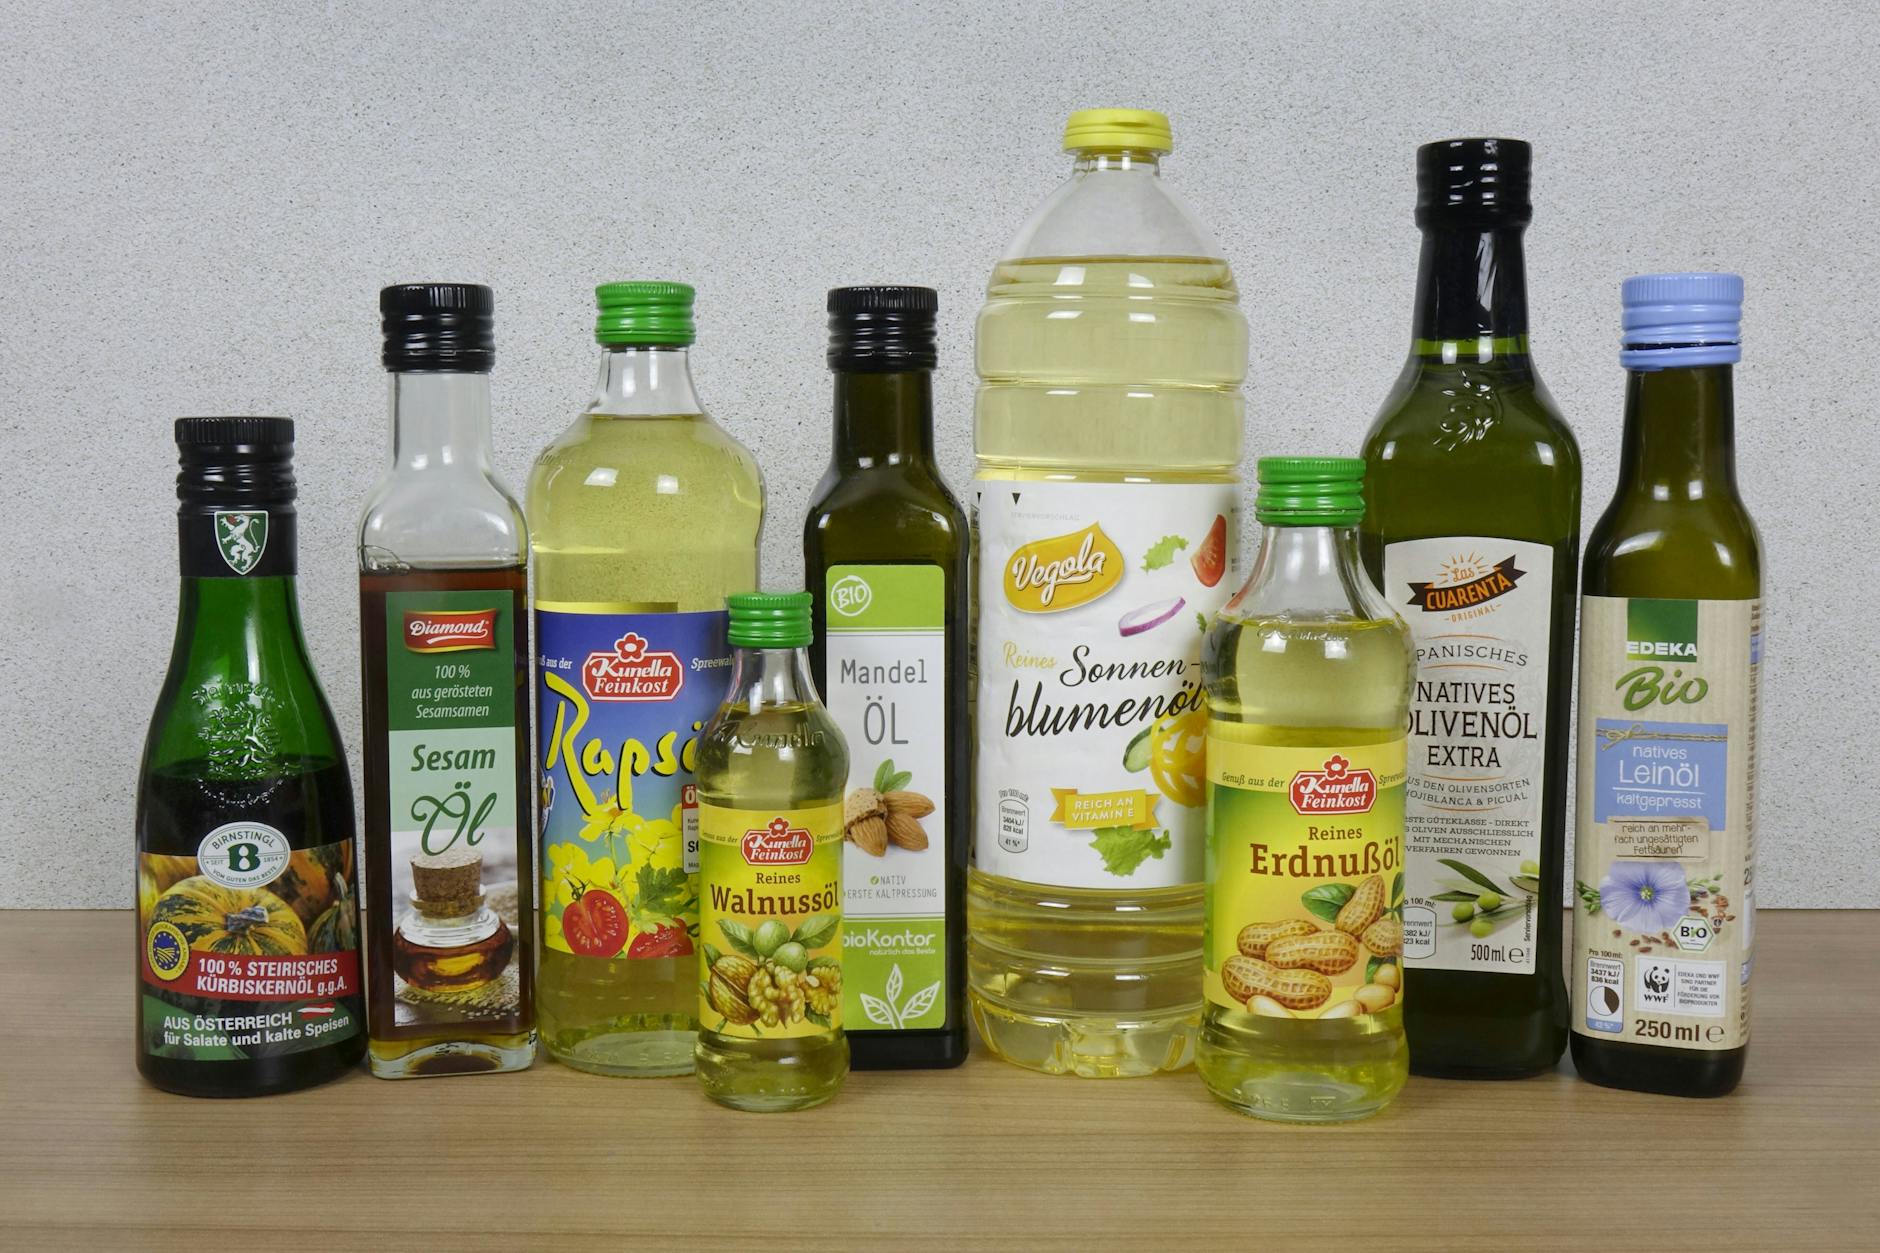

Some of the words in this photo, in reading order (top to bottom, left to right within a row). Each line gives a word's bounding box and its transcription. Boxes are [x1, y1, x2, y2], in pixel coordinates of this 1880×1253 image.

[1012, 532, 1105, 605] Vegola
[1452, 566, 1474, 582] Las
[836, 584, 867, 609] BIO
[1427, 572, 1512, 609] CUARENTA
[410, 620, 488, 638] Diamond
[1416, 645, 1528, 667] PANISCHES
[1626, 642, 1698, 656] EDEKA
[546, 658, 558, 668] aus
[559, 657, 573, 669] der
[588, 658, 672, 677] Kunella
[1003, 641, 1057, 670] Reines
[1060, 645, 1200, 687] Sonnen-
[434, 665, 456, 678] 100
[458, 665, 470, 678] %
[841, 660, 927, 684] Mandel
[411, 686, 432, 699] aus
[434, 685, 492, 701] gerösteten
[594, 677, 668, 694] Feinkost
[1417, 682, 1515, 705] NATIVES
[1616, 666, 1708, 711] Bio
[416, 704, 489, 718] Sesamsamen
[1005, 679, 1203, 737] blumenöl
[864, 696, 908, 745] ÖL
[411, 745, 496, 772] Sesam
[1427, 745, 1501, 768] EXTRA
[1633, 745, 1687, 760] natives
[1619, 760, 1699, 787] Leinöl
[1248, 778, 1264, 787] aus
[1268, 778, 1285, 788] der
[1297, 776, 1369, 794] Kunella
[1407, 776, 1420, 786] US
[1423, 781, 1444, 792] DEN
[1448, 778, 1530, 793] OLIVENSORTEN
[1075, 799, 1112, 810] REICH
[1116, 796, 1134, 806] AN
[1301, 793, 1366, 808] Feinkost
[1488, 792, 1528, 805] PICUAL
[1617, 793, 1701, 811] kaltgepresst
[411, 781, 497, 856] Öl
[1072, 811, 1124, 822] VITAMIN
[1128, 808, 1134, 817] E
[1427, 816, 1487, 826] GÜTEKLASSE
[1308, 826, 1362, 841] Reines
[1450, 828, 1534, 837] AUSSCHLIESSLICH
[1622, 824, 1645, 832] reich
[212, 831, 275, 850] BIRNSTINGL
[747, 834, 806, 848] Kunella
[1434, 837, 1511, 846] MECHANISCHEN
[1615, 835, 1634, 844] fach
[1637, 835, 1699, 847] ungesättigten
[750, 848, 803, 860] Feinkost
[1250, 836, 1400, 878] Erdnußöl
[1406, 846, 1462, 854] VERFAHREN
[1465, 848, 1520, 856] GEWONNEN
[1634, 845, 1683, 854] Fettsäuren
[261, 866, 277, 879] BESTE
[756, 873, 800, 884] Reines
[880, 876, 906, 885] NATIV
[710, 882, 839, 915] Walnussöl
[848, 889, 872, 899] ERSTE
[876, 888, 937, 898] KALTPRESSUNG
[200, 958, 225, 974] 100
[228, 961, 242, 976] %
[247, 959, 338, 976] STEIRISCHES
[1590, 961, 1621, 970] Brennwert
[197, 974, 314, 995] KÜRBISKERNÖL
[317, 976, 347, 996] g.g.A.
[1644, 994, 1668, 1003] WWF
[164, 1016, 190, 1030] AUS
[194, 1012, 292, 1031] ÖSTERREICH
[164, 1031, 180, 1045] für
[184, 1032, 227, 1046] Salate
[232, 1032, 260, 1046] und
[265, 1028, 301, 1043] kalte
[305, 1015, 349, 1038] Speisen
[1635, 1019, 1671, 1039] 250
[1676, 1023, 1700, 1042] ml
